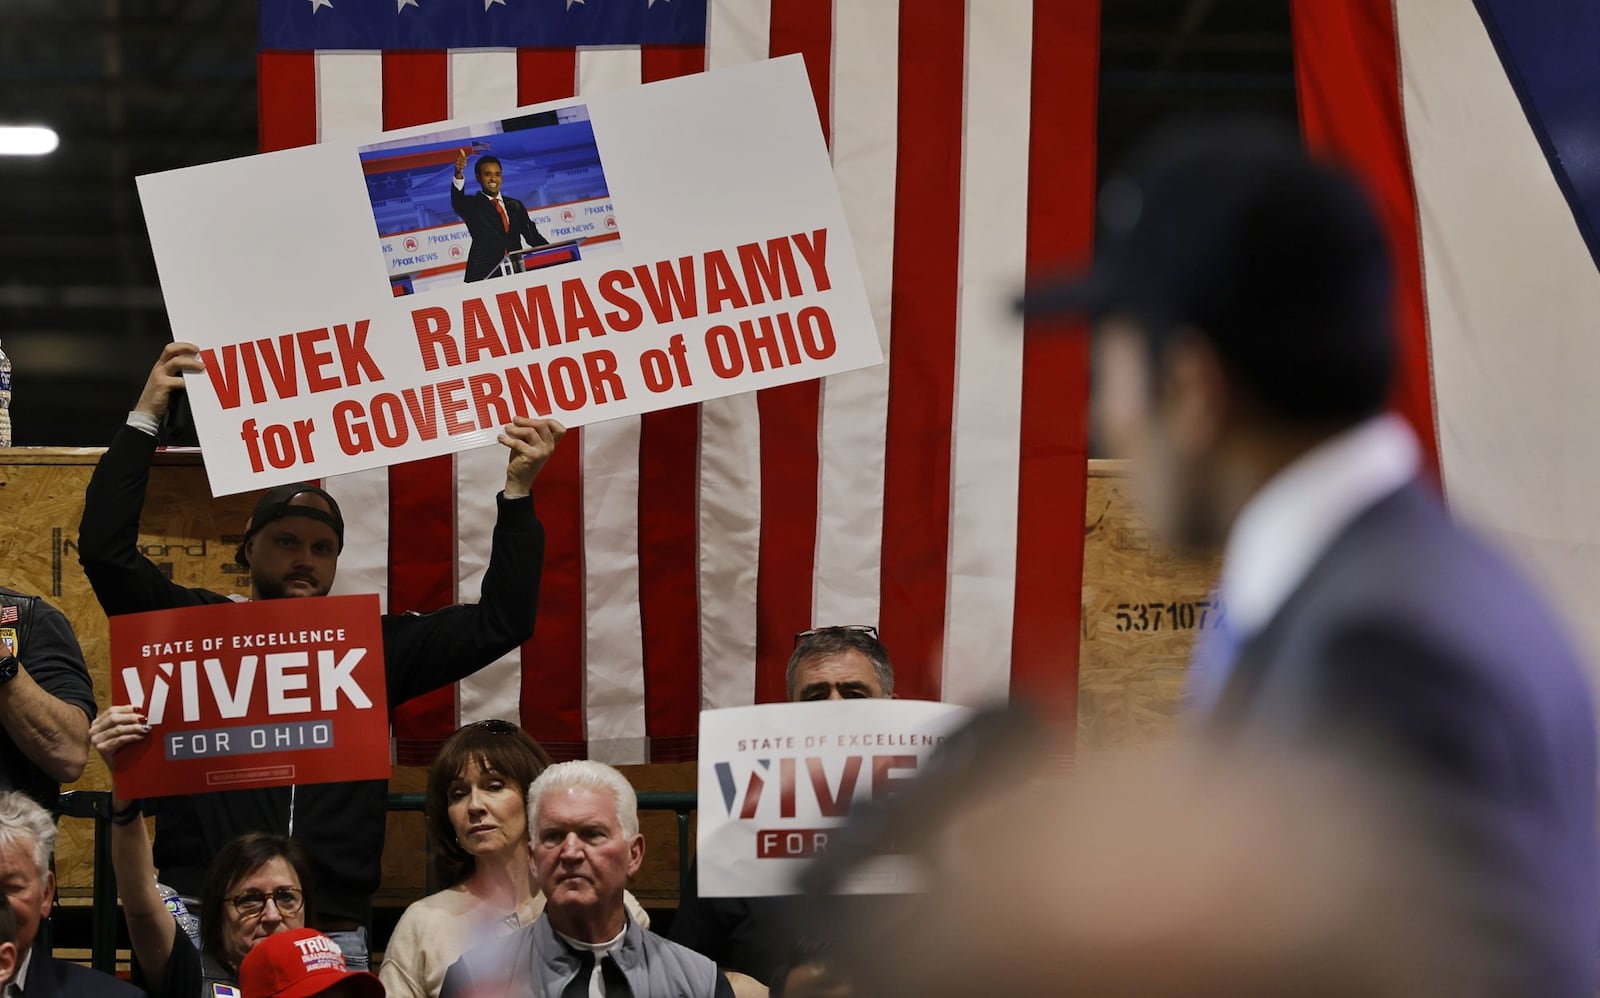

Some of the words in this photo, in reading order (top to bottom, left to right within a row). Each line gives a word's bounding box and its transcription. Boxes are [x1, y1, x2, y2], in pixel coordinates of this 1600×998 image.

[573, 222, 595, 232] NEWS
[415, 252, 439, 264] NEWS
[200, 319, 385, 410] VIVEK
[411, 228, 832, 372] RAMASWAMY
[241, 418, 315, 473] for
[332, 349, 627, 456] GOVERNOR
[639, 333, 693, 393] of
[704, 306, 837, 379] OHIO
[142, 640, 194, 658] STATE
[202, 637, 224, 651] OF
[232, 629, 346, 648] EXCELLENCE
[121, 648, 373, 726] VIVEK
[171, 732, 230, 756] FOR
[250, 724, 329, 749] OHIO
[738, 737, 795, 751] STATE
[804, 735, 827, 748] OF
[714, 755, 918, 819] VIVE
[763, 833, 829, 855] FOR
